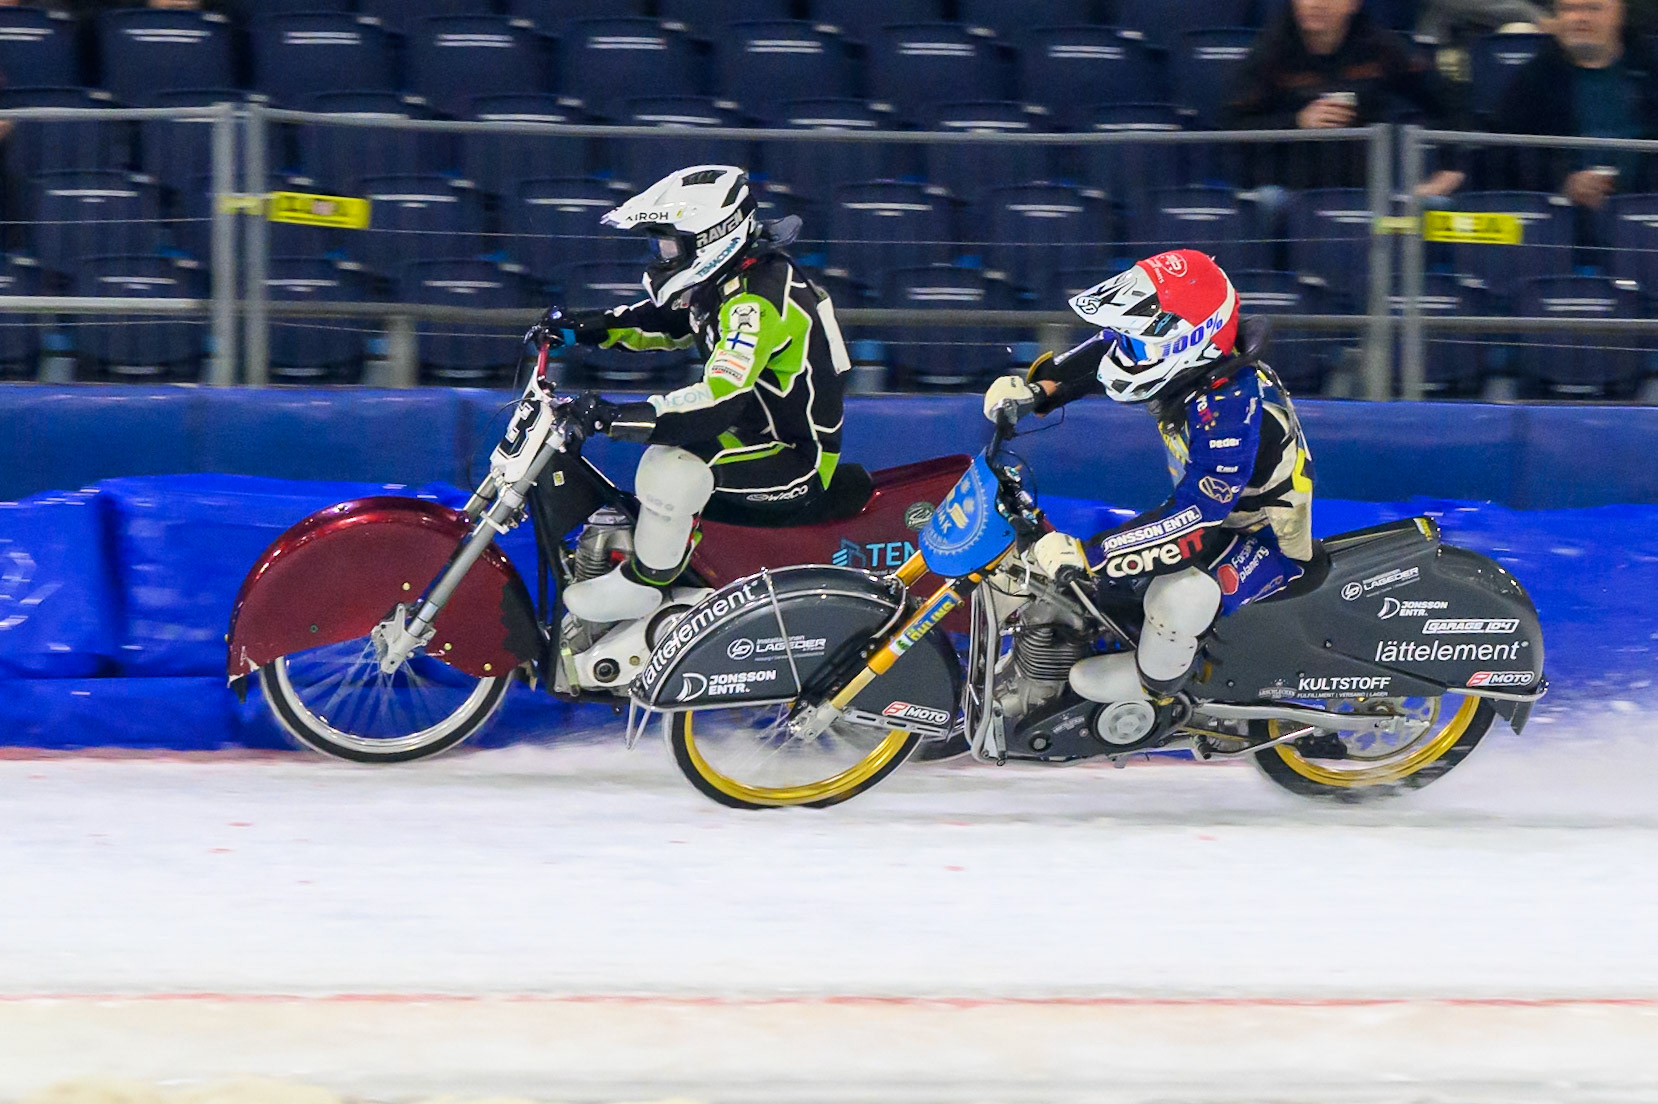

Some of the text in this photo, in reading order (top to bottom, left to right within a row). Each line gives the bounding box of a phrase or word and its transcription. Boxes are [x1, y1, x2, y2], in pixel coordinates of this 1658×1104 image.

[625, 212, 669, 221] AIROH
[1161, 311, 1224, 359] 100%
[1104, 509, 1200, 552] JONSSON ENTR.
[1399, 608, 1429, 617] ENTR.
[1400, 601, 1449, 610] JONSSON
[1374, 640, 1520, 662] lättelement
[708, 669, 777, 686] JONSSON
[1298, 677, 1391, 691] KULTSTOFF
[1489, 673, 1533, 684] MOTO
[708, 683, 751, 696] ENTR.
[905, 706, 948, 723] MOTO
